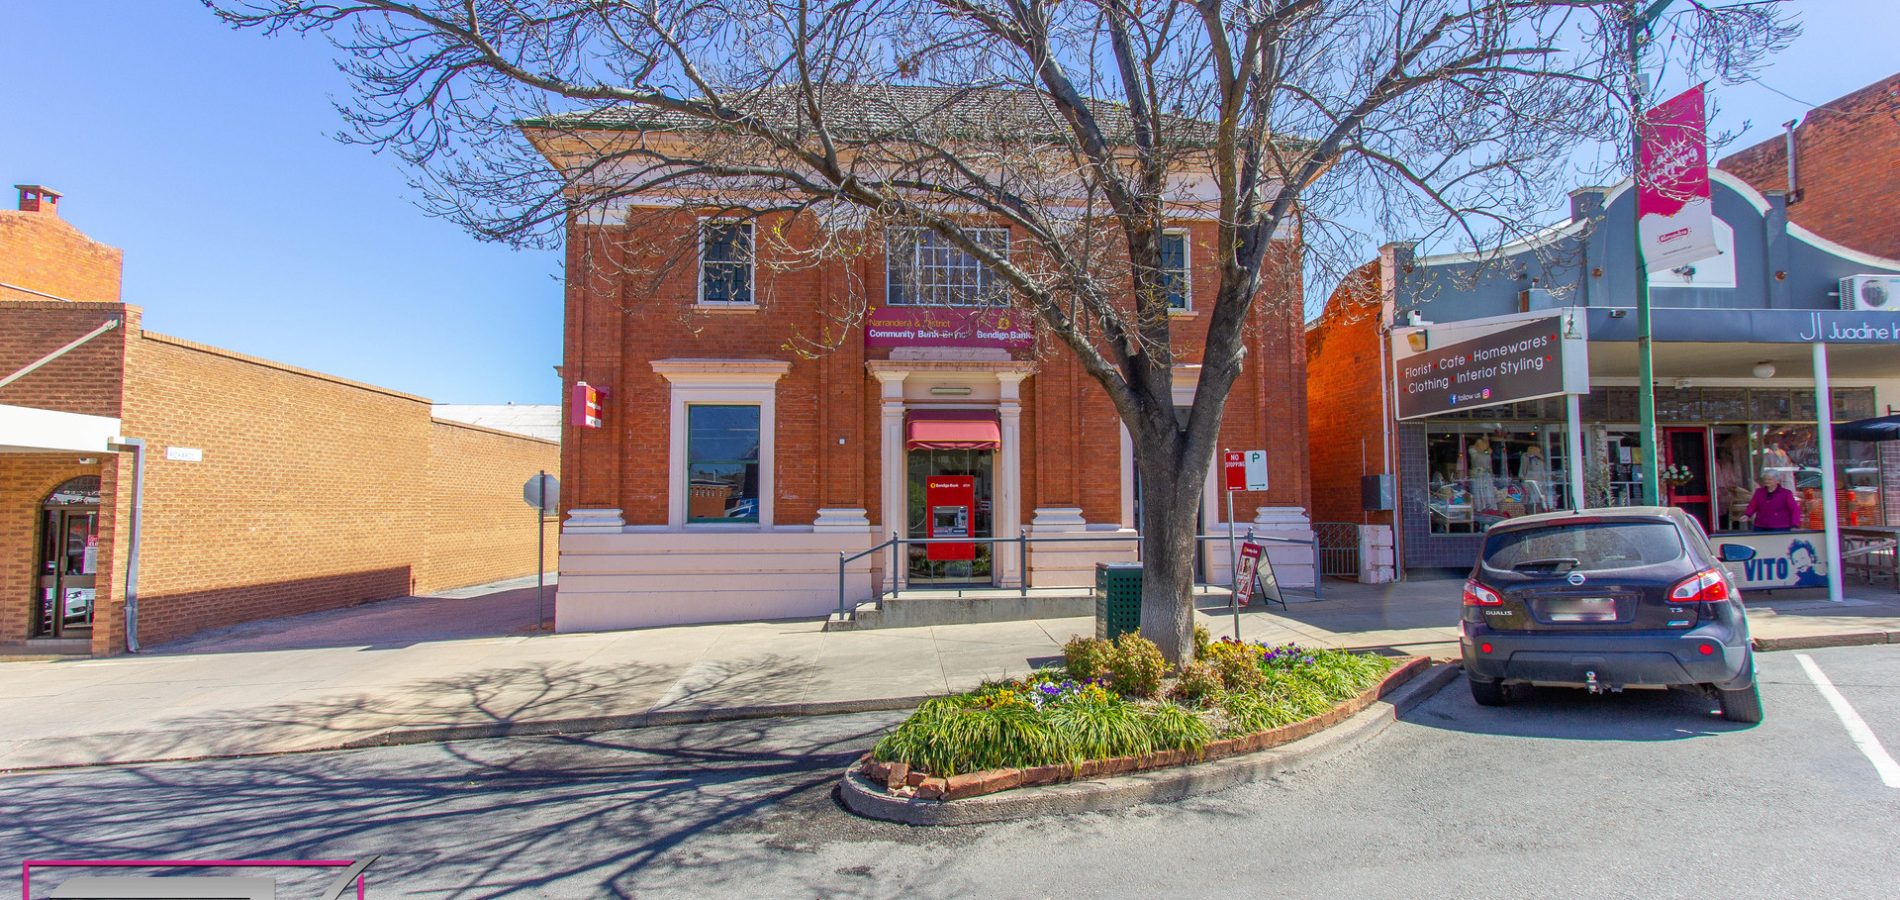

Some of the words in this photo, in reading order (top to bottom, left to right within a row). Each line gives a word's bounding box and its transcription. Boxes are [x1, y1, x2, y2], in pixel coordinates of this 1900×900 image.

[869, 319, 912, 327] Narrandera
[869, 329, 915, 340] Community
[918, 330, 939, 338] Bank
[976, 330, 1010, 341] Bendigo
[1010, 331, 1032, 339] Bank
[1829, 322, 1889, 340] Juadine
[1405, 362, 1432, 378] Florist
[1439, 354, 1466, 371] Cafe
[1473, 335, 1548, 363] Homewares
[1408, 376, 1449, 394] Clothing
[1456, 366, 1497, 384] Interior
[1500, 356, 1544, 375] Styling
[1457, 393, 1474, 402] follow
[1252, 452, 1260, 463] P
[1743, 557, 1788, 581] VITO
